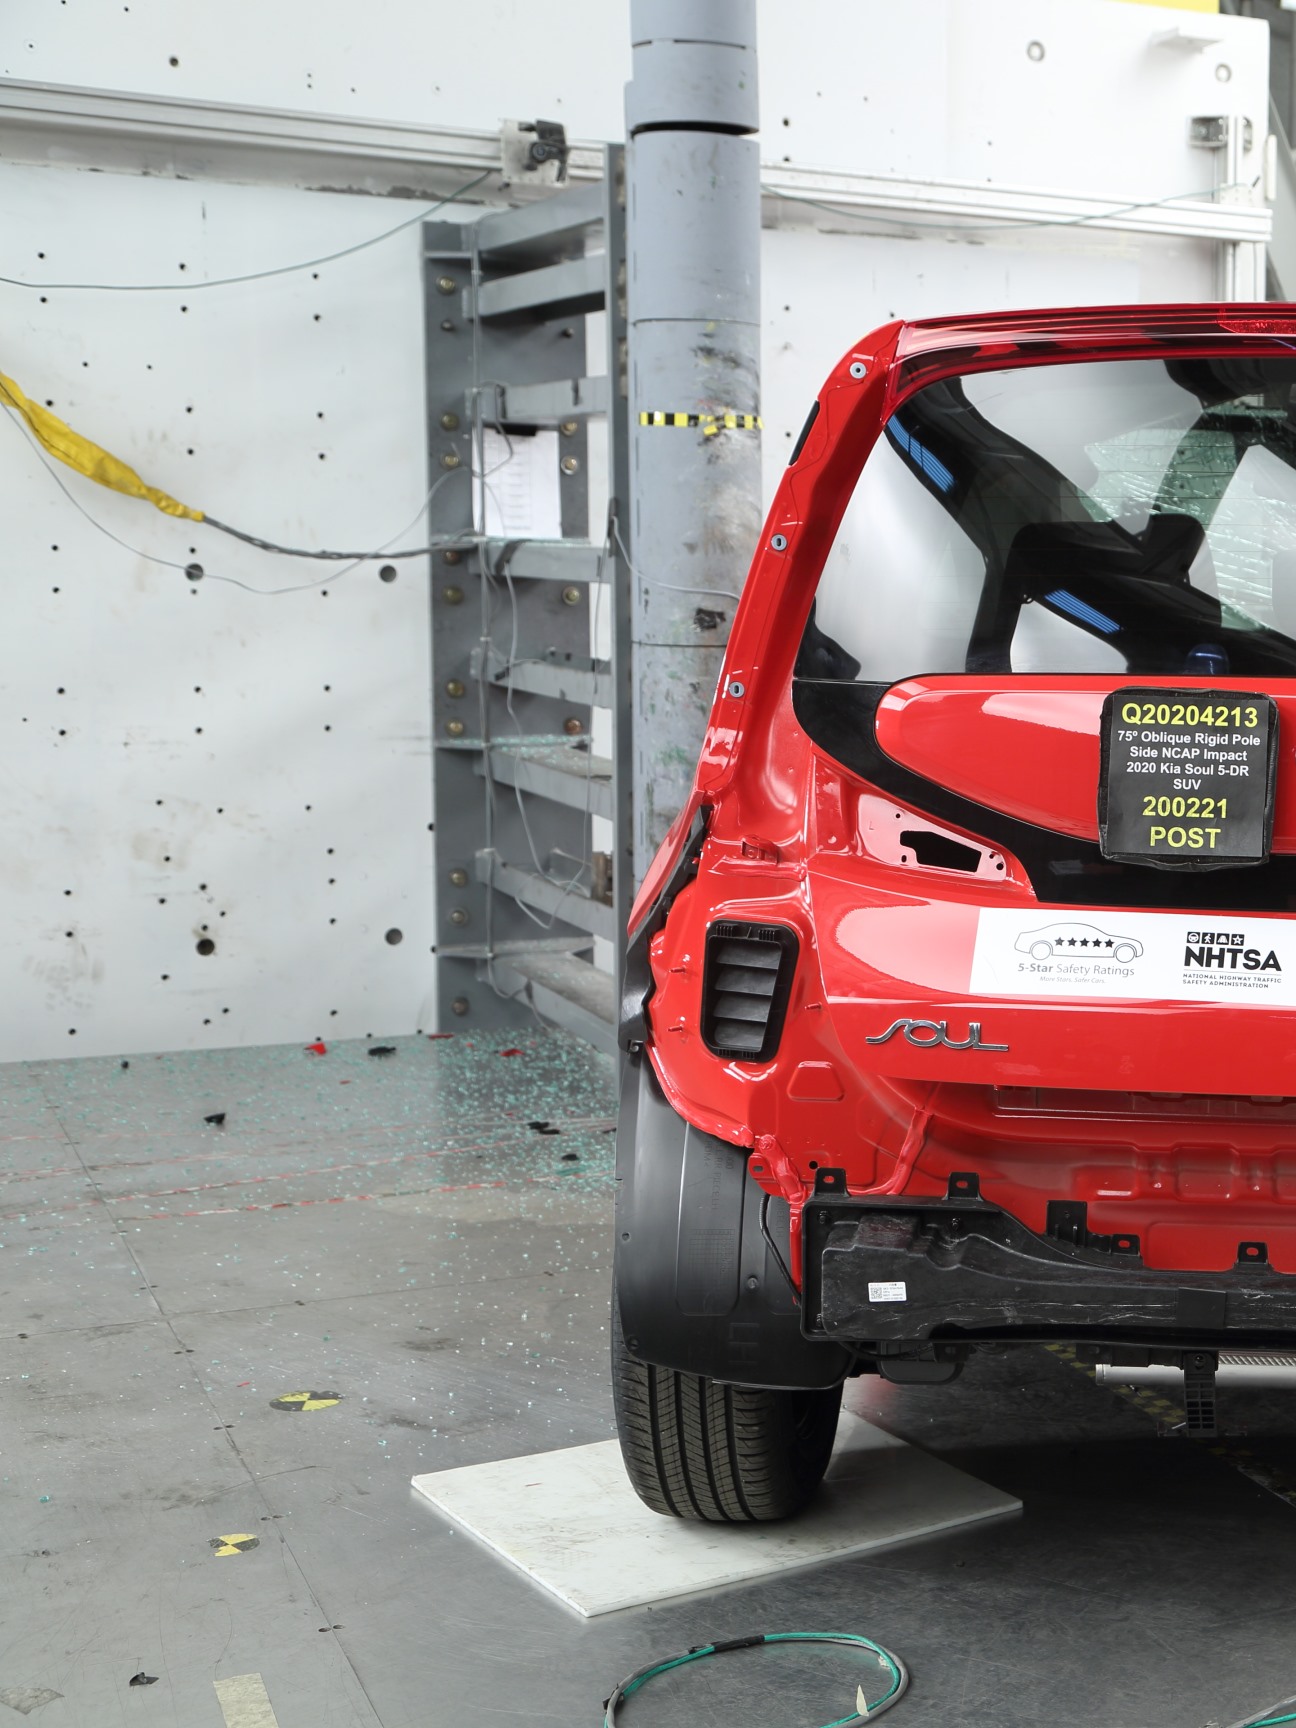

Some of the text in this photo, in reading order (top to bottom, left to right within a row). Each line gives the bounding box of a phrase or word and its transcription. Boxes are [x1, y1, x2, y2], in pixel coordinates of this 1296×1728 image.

[1122, 703, 1258, 728] Q20204213
[1142, 731, 1191, 746] Oblique
[1195, 732, 1228, 747] Rigid
[1232, 734, 1260, 746] Pole
[1130, 746, 1248, 763] Side NCAP Impact
[1127, 762, 1249, 776] 2020 Kia Soul 5-DR
[1173, 778, 1201, 790] SUV
[1142, 796, 1228, 819] 200221
[1150, 826, 1221, 849] POST
[1184, 946, 1282, 972] NHTSA
[1018, 963, 1135, 978] 5-Star Safety Ratings
